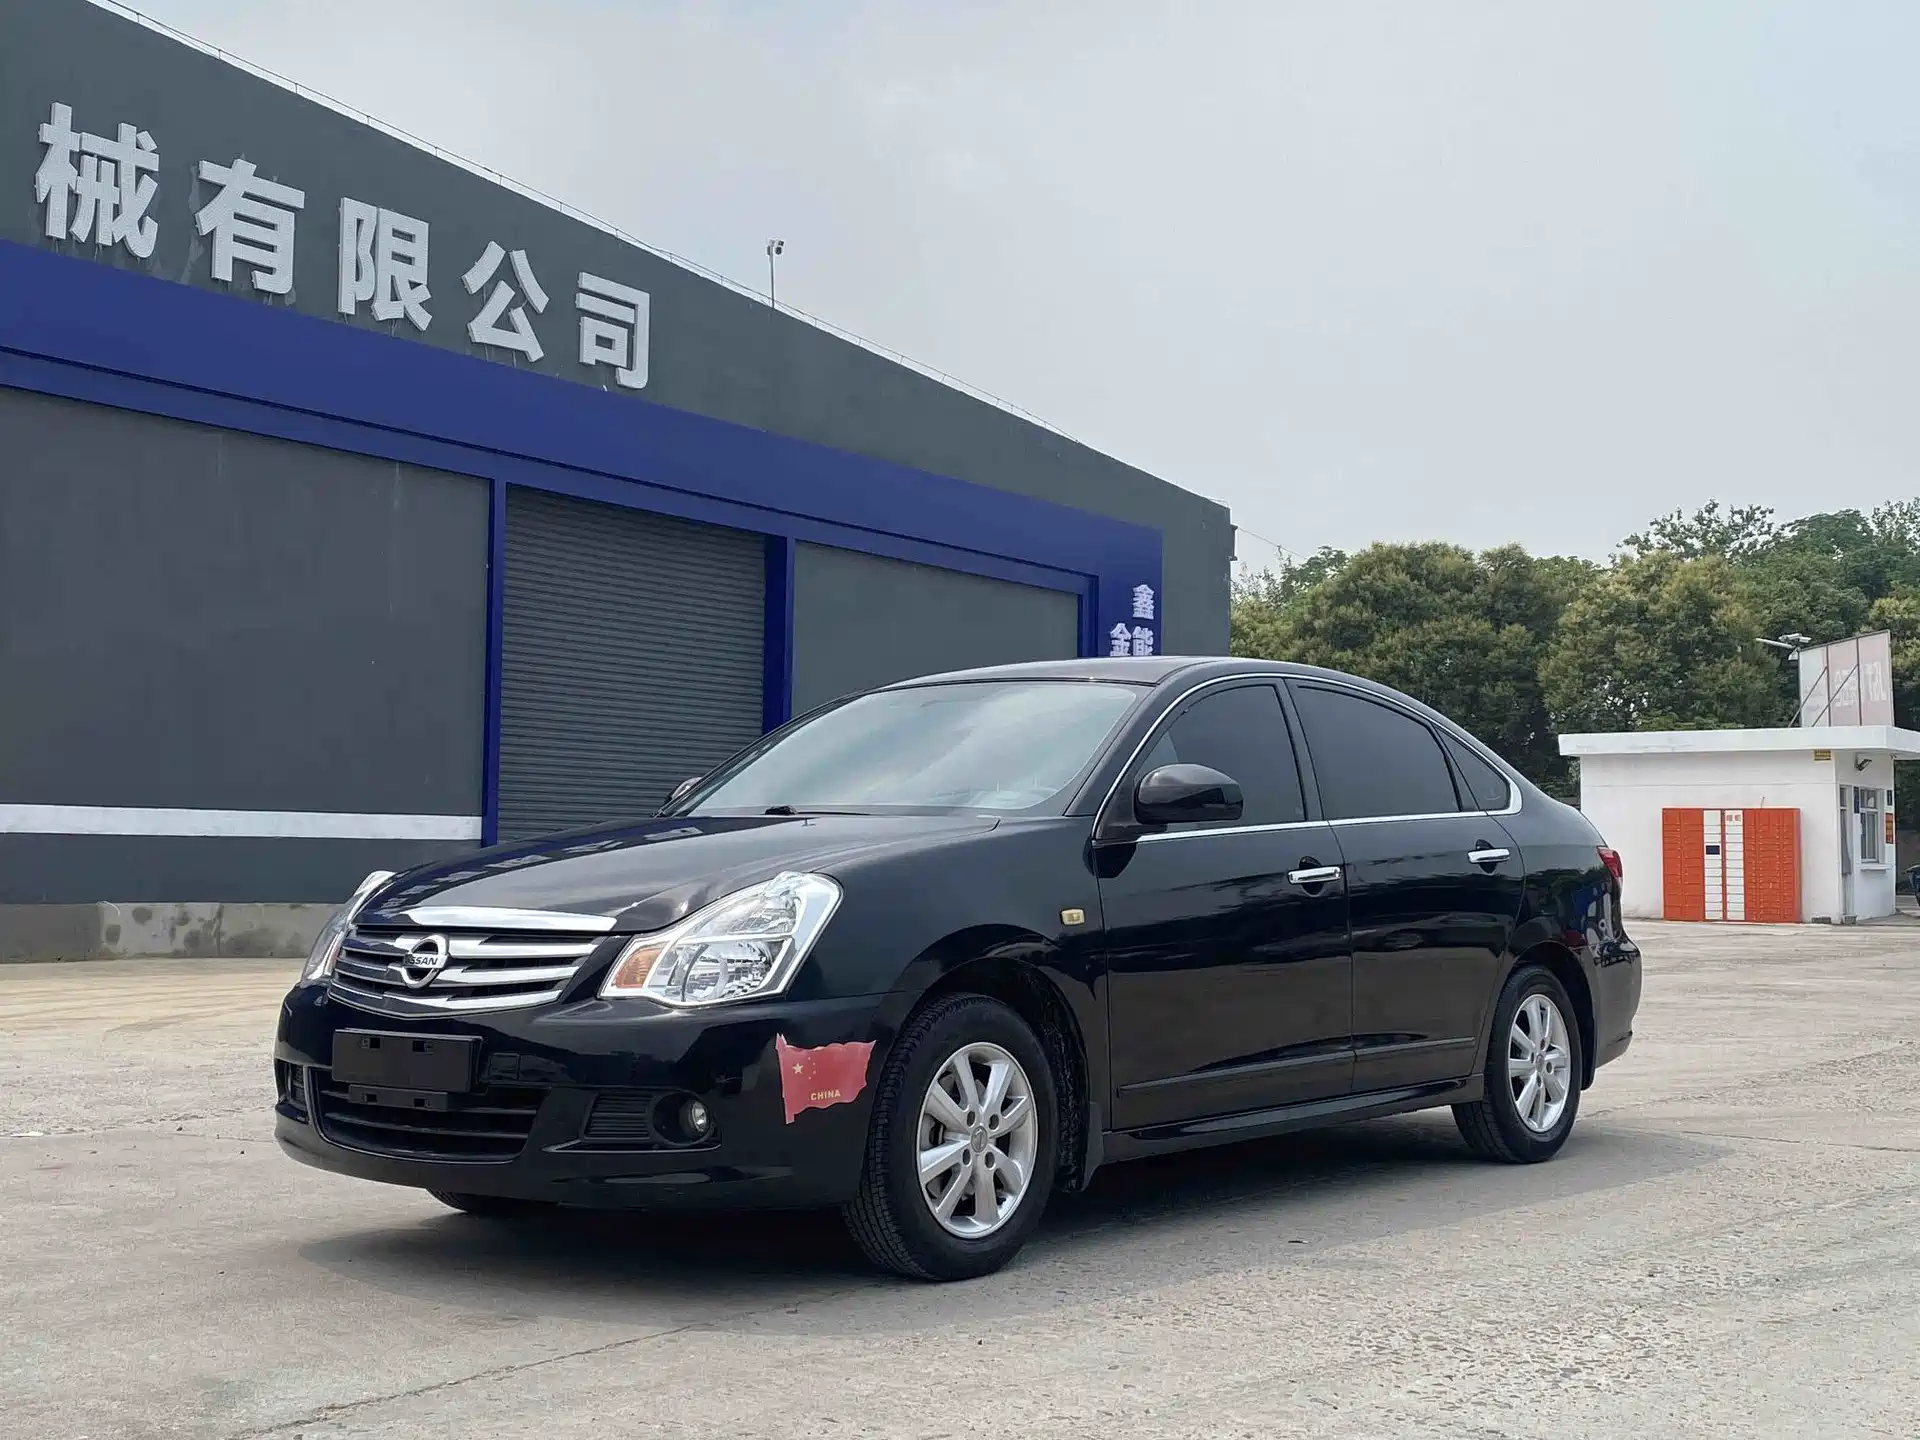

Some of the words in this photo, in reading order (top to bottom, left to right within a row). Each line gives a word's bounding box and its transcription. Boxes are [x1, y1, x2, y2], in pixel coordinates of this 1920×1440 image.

[36, 102, 650, 389] 械有限公司
[405, 956, 438, 966] ISSAN
[811, 1089, 841, 1101] CHINA
